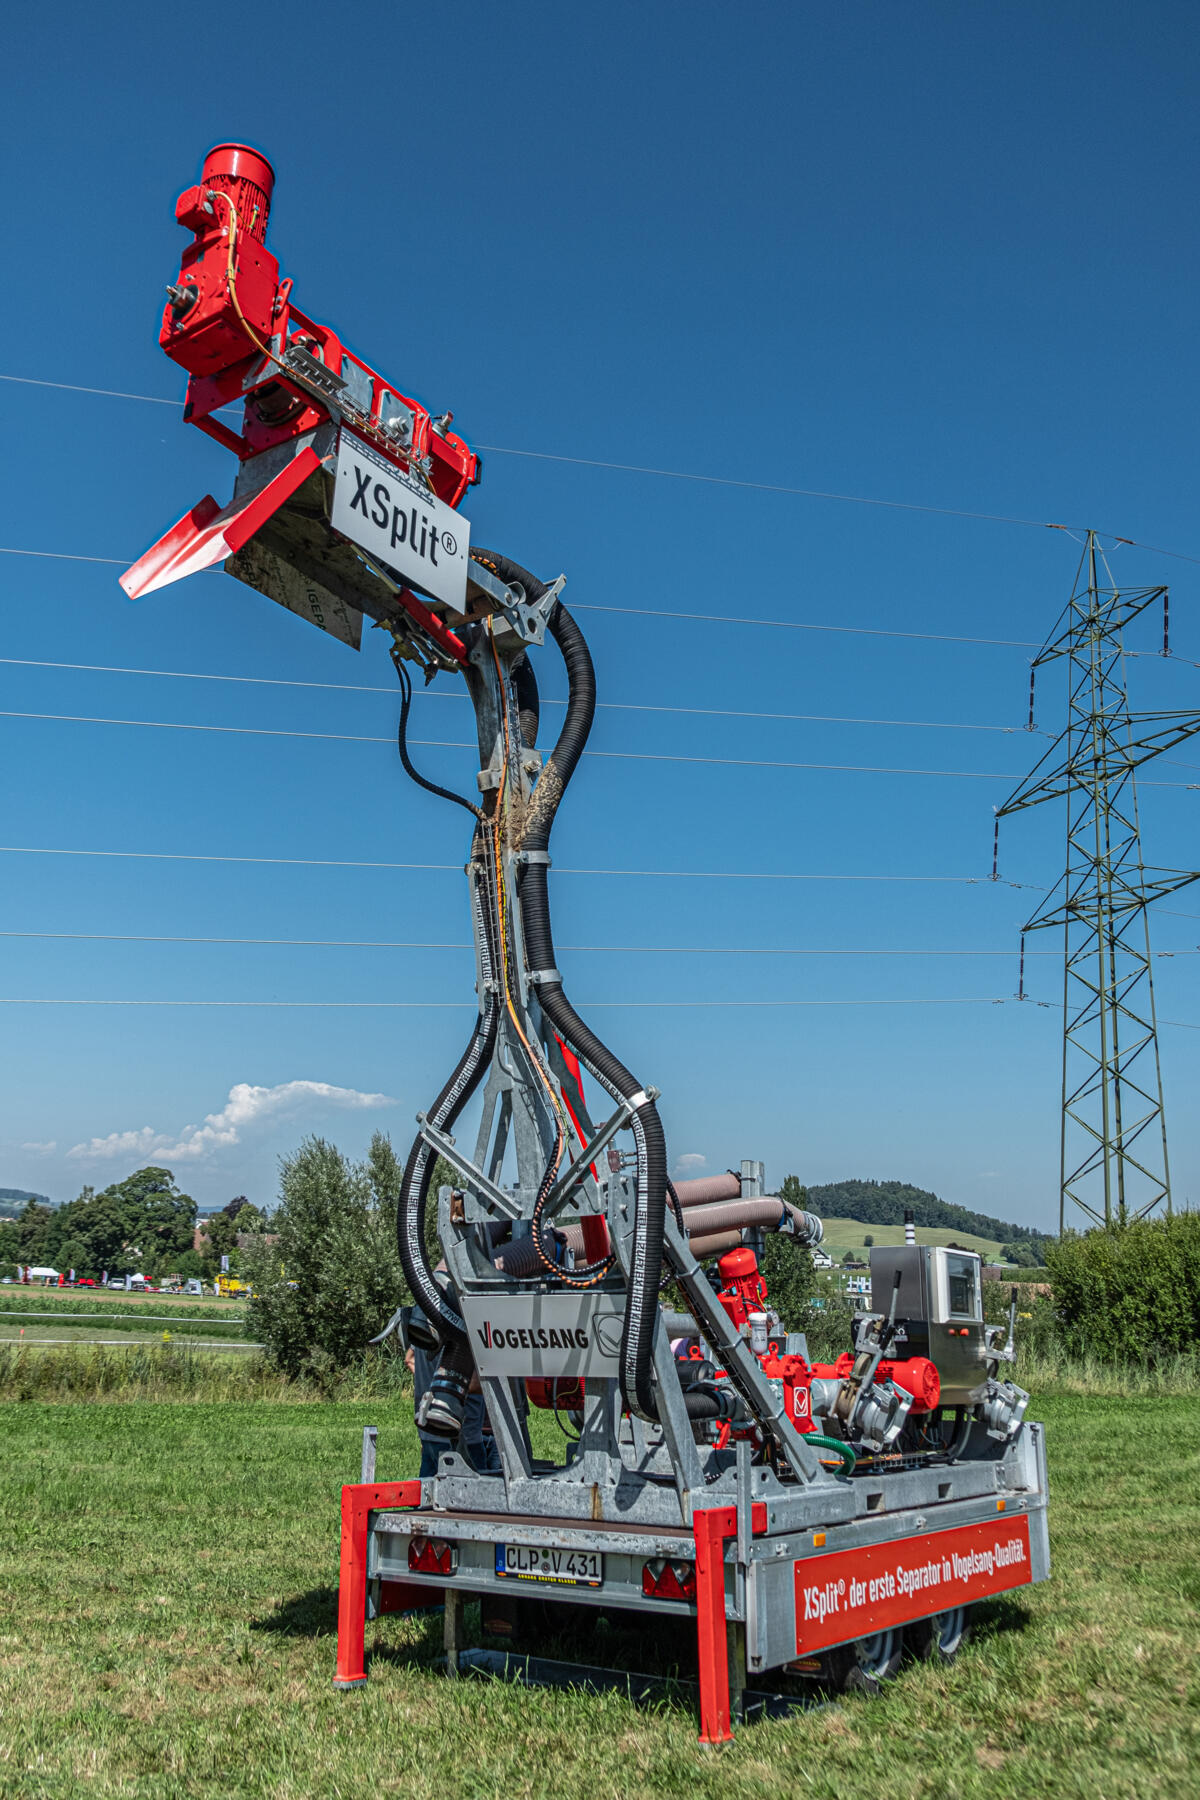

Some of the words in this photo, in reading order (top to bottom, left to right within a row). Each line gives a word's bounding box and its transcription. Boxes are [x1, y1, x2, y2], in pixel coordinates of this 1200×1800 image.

[477, 1321, 589, 1349] VOGELSANG
[506, 1547, 539, 1571] CLP
[551, 1551, 562, 1574] V
[566, 1553, 600, 1578] 431
[849, 1577, 867, 1608] der
[869, 1571, 895, 1602] erste
[896, 1565, 941, 1599] Separator
[942, 1555, 952, 1583] in
